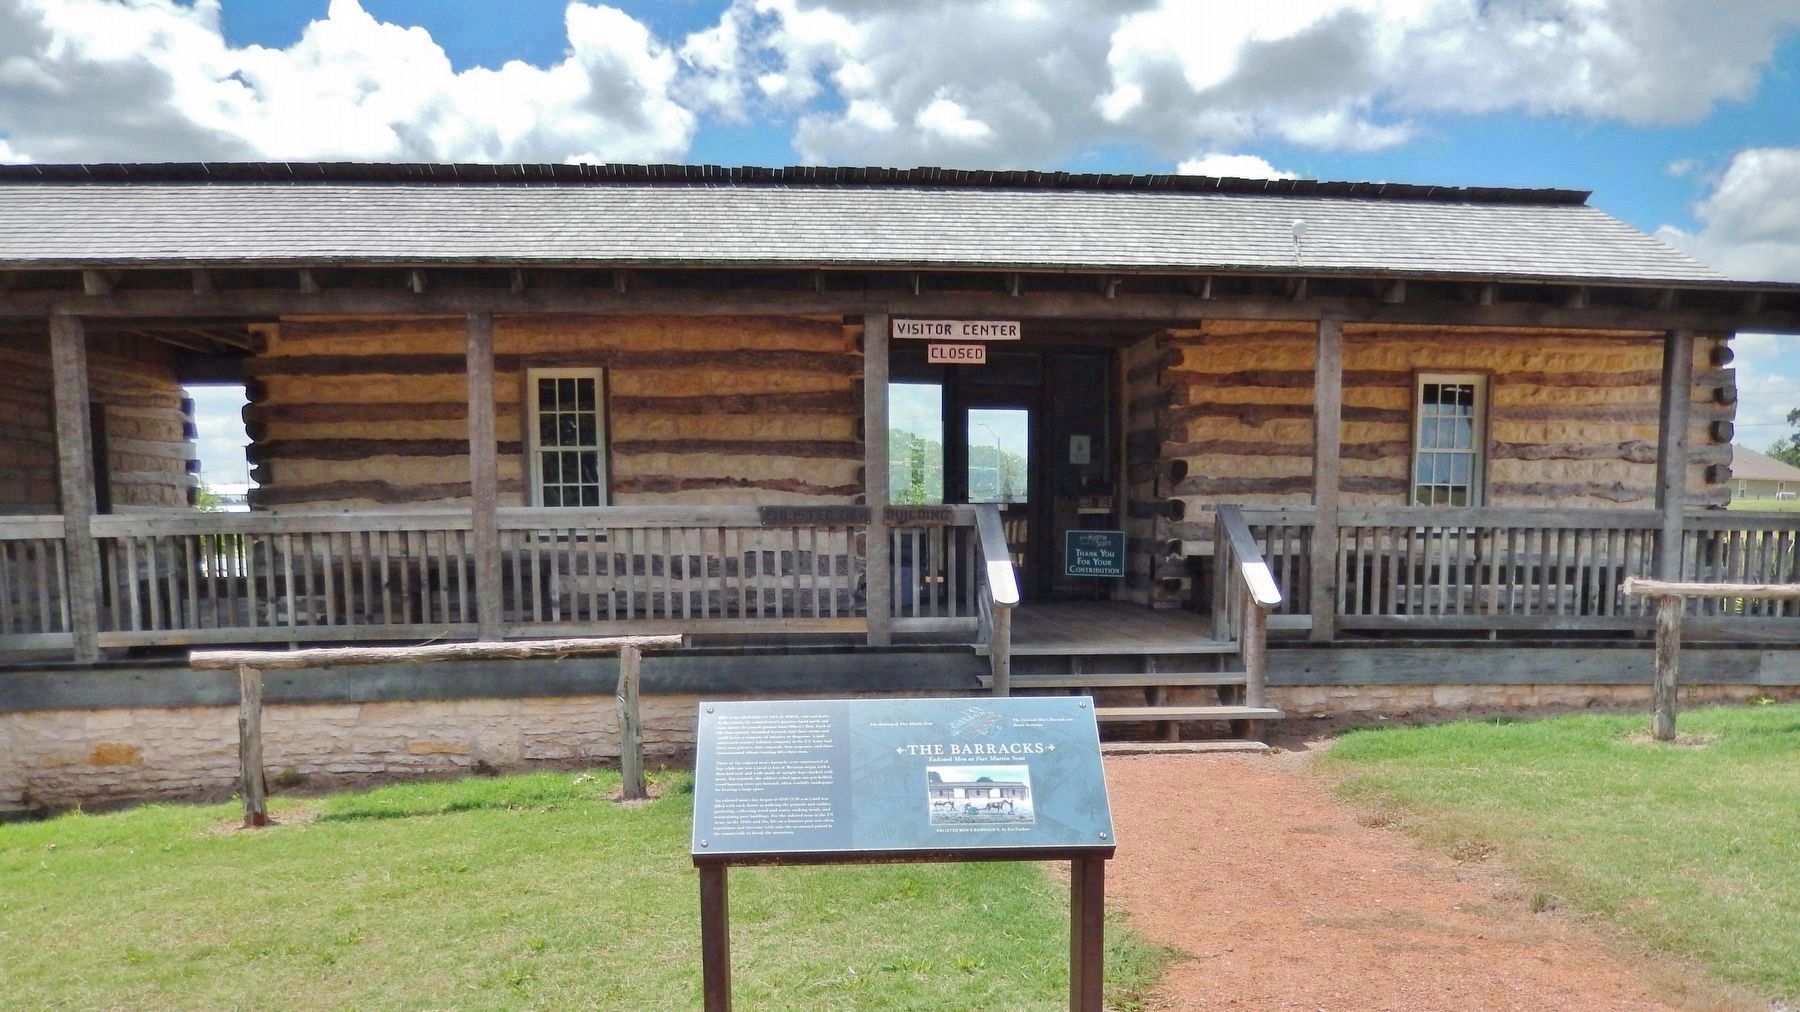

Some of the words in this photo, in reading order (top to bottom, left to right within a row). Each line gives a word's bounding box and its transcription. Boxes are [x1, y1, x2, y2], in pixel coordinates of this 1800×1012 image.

[897, 323, 952, 336] VISITOR
[962, 324, 1017, 336] CENTER
[931, 347, 983, 359] CLOSED
[885, 508, 949, 520] BUILDING
[1076, 549, 1098, 557] THANK
[1100, 549, 1115, 557] YOU
[1077, 557, 1090, 566] FOR
[1093, 557, 1112, 566] YOUR
[1070, 565, 1120, 574] CONTRIBUTION
[906, 744, 944, 755] THE
[951, 743, 1044, 755] BARRACKS
